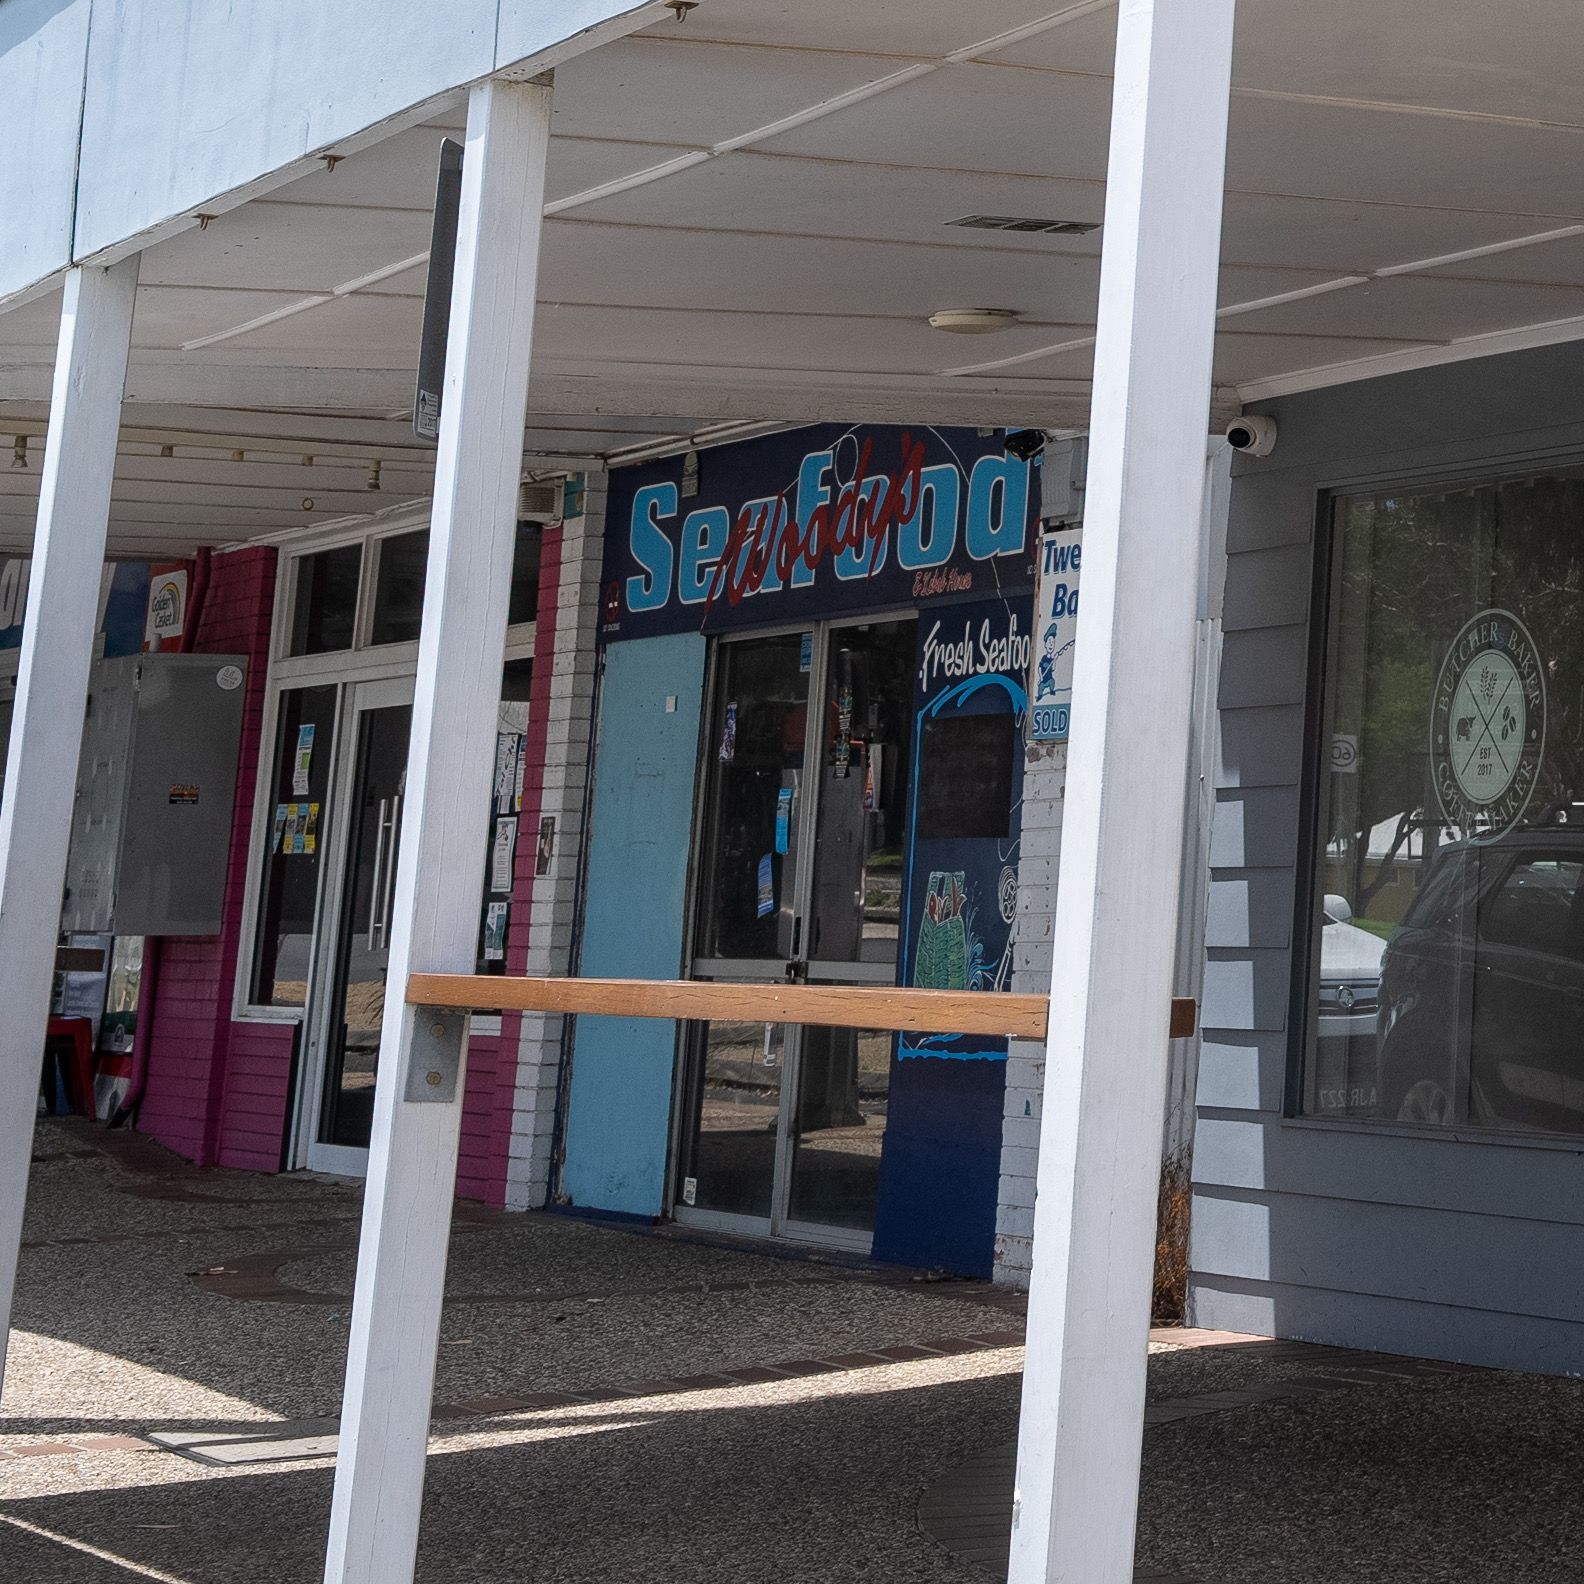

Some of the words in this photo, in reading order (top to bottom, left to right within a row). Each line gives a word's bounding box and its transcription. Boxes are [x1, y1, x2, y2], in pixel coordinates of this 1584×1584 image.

[626, 427, 1032, 613] Seafood
[704, 432, 925, 613] Woody's
[922, 620, 974, 692] Fresh
[1439, 621, 1501, 713] BUTCHER
[1507, 628, 1540, 710] BAKER
[1033, 709, 1068, 735] SOLD
[1480, 747, 1491, 759] EST
[1477, 764, 1493, 776] 2017
